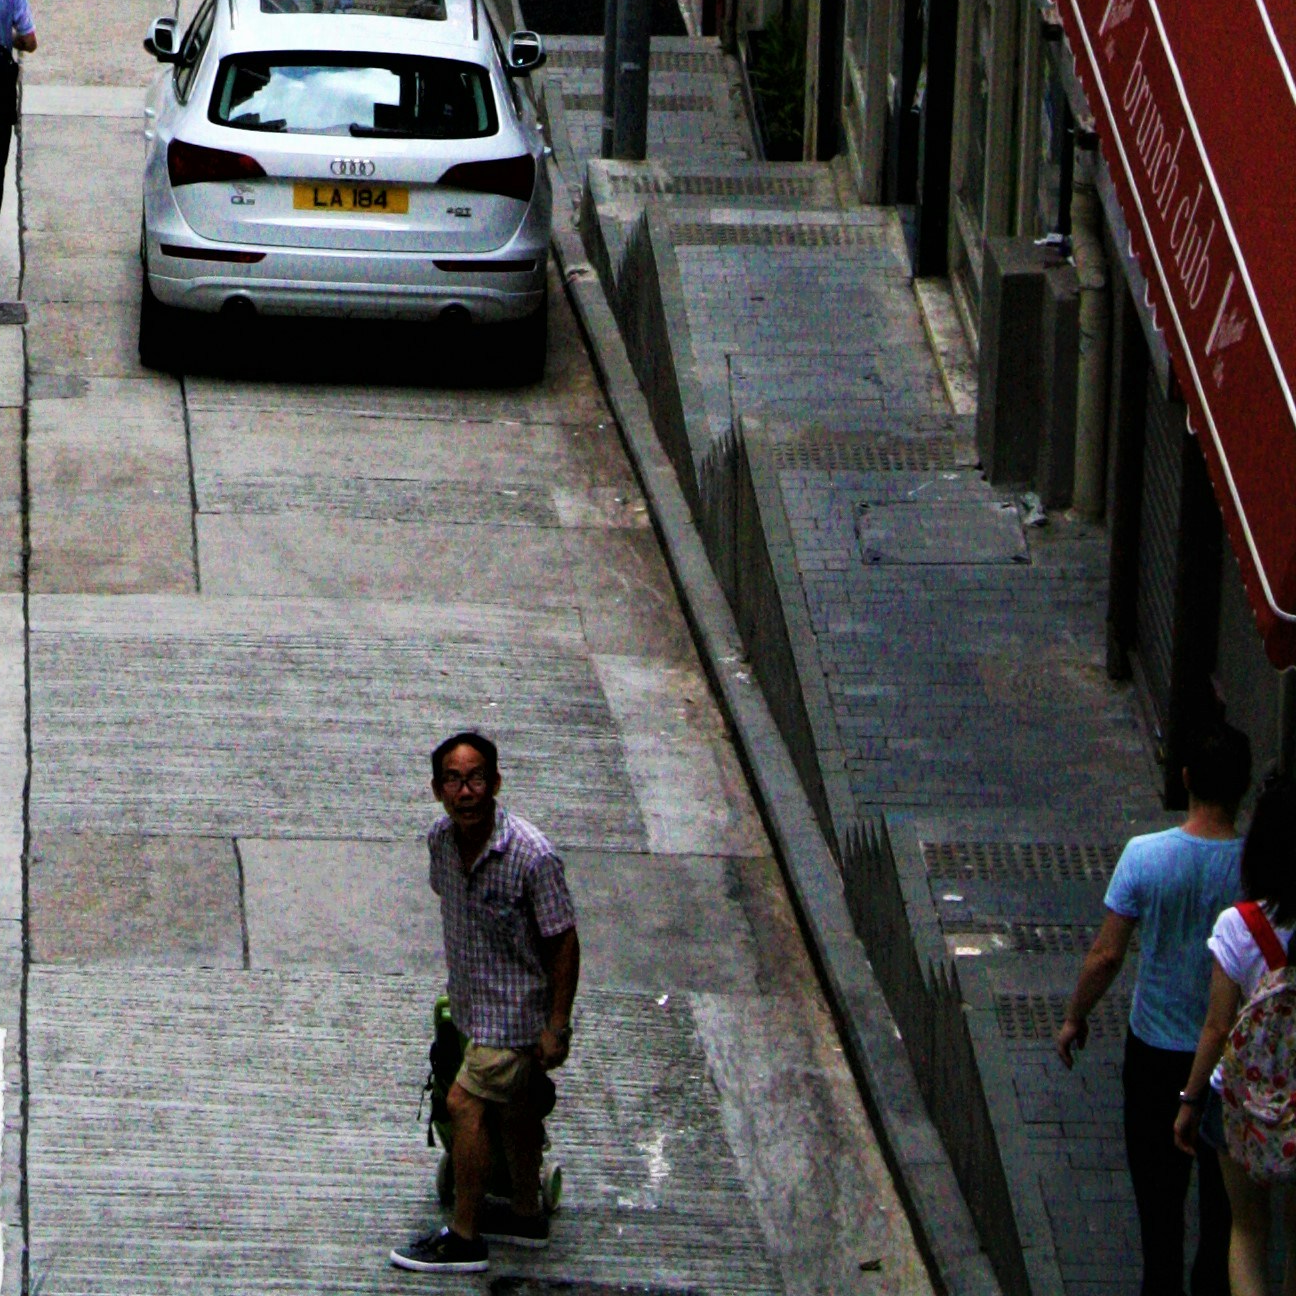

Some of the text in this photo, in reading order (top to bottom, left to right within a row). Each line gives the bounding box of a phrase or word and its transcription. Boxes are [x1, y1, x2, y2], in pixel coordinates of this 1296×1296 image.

[313, 188, 388, 209] LA 184
[1123, 27, 1215, 309] brunch club
